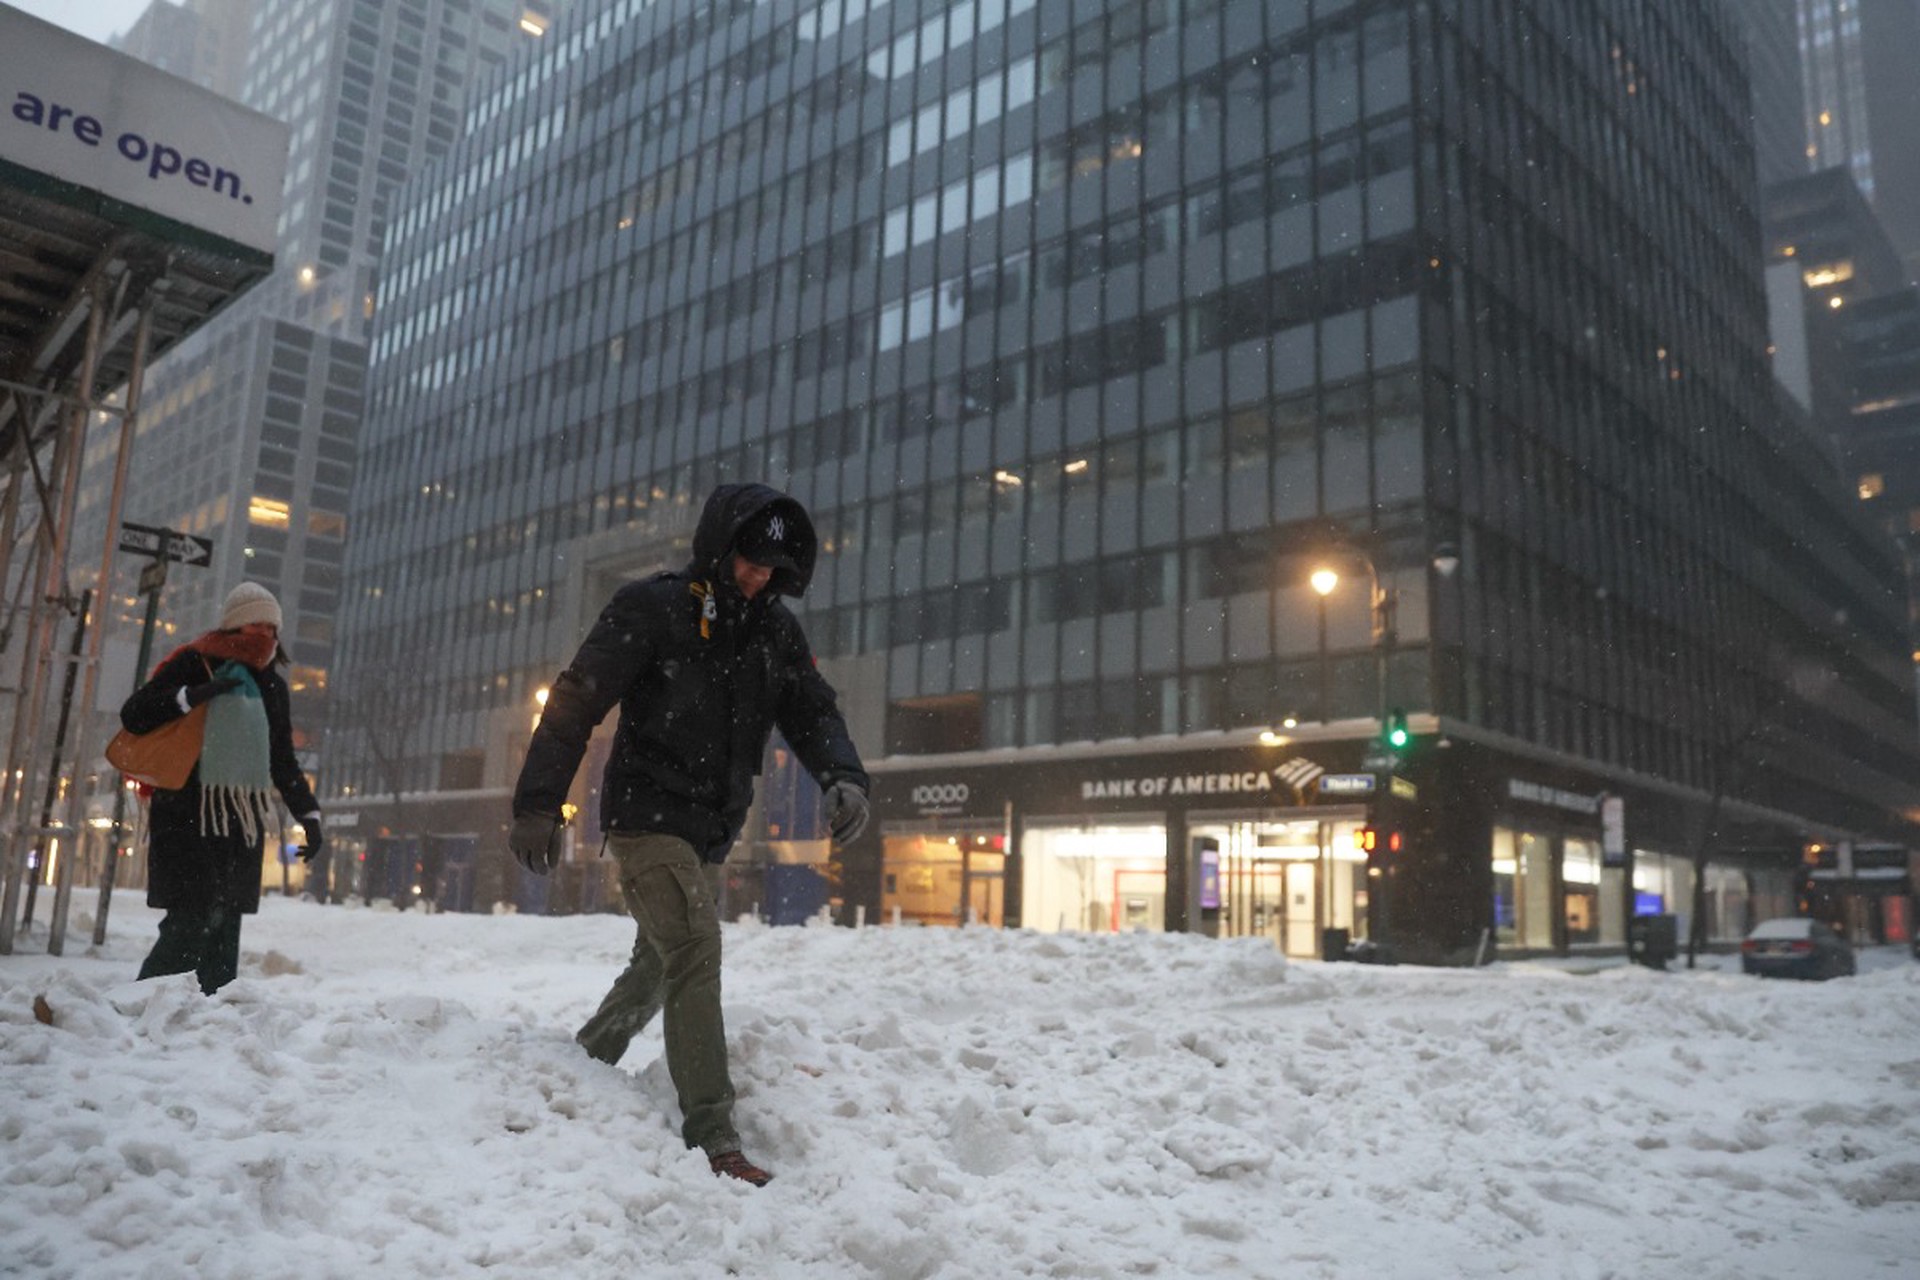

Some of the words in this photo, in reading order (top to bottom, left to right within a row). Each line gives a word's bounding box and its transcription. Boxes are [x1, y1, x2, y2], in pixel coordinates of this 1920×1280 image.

[12, 91, 103, 147] are
[117, 132, 254, 205] open.
[766, 515, 785, 541] NY
[122, 530, 149, 549] ONE
[168, 540, 197, 558] WAY
[1082, 780, 1136, 799] BANK
[1140, 777, 1168, 797] OF
[1169, 771, 1271, 795] AMERICA
